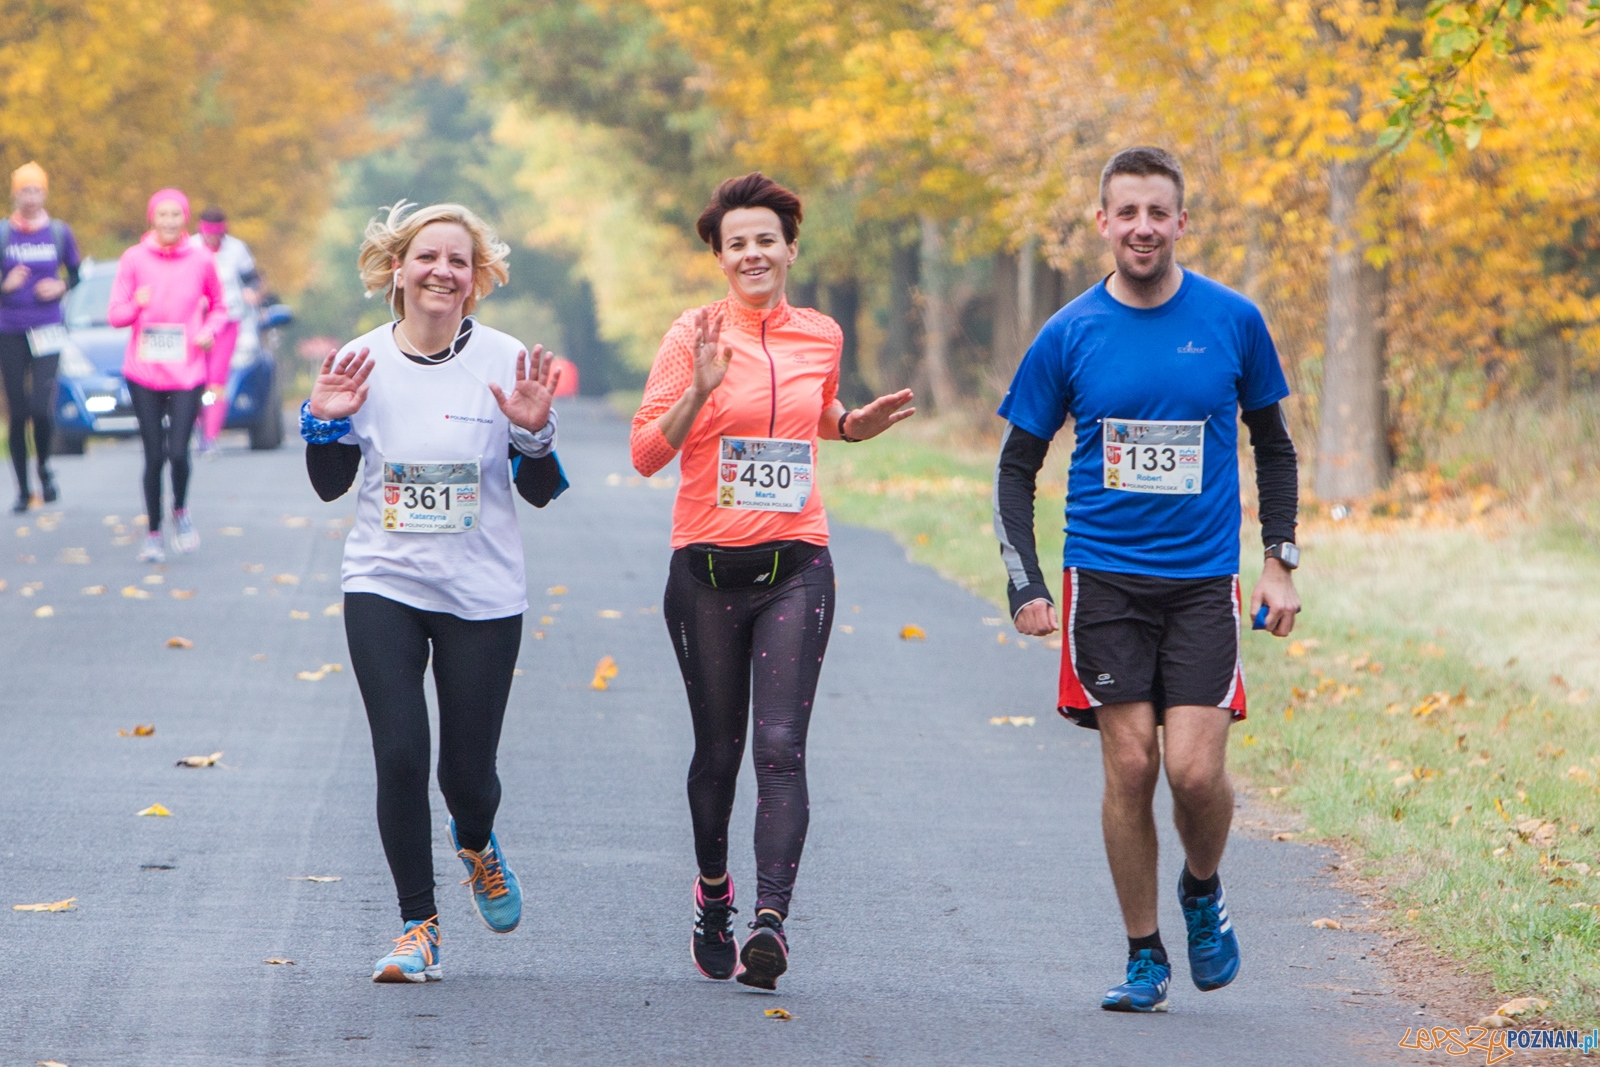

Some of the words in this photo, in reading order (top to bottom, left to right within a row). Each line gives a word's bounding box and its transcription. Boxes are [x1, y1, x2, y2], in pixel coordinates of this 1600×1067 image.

[1126, 446, 1176, 472] 133
[740, 463, 791, 489] 430
[1136, 474, 1162, 482] Robert
[1127, 482, 1154, 490] POLINOVA
[403, 486, 450, 510] 361
[755, 491, 776, 499] Marta
[409, 512, 447, 521] Katarzyna
